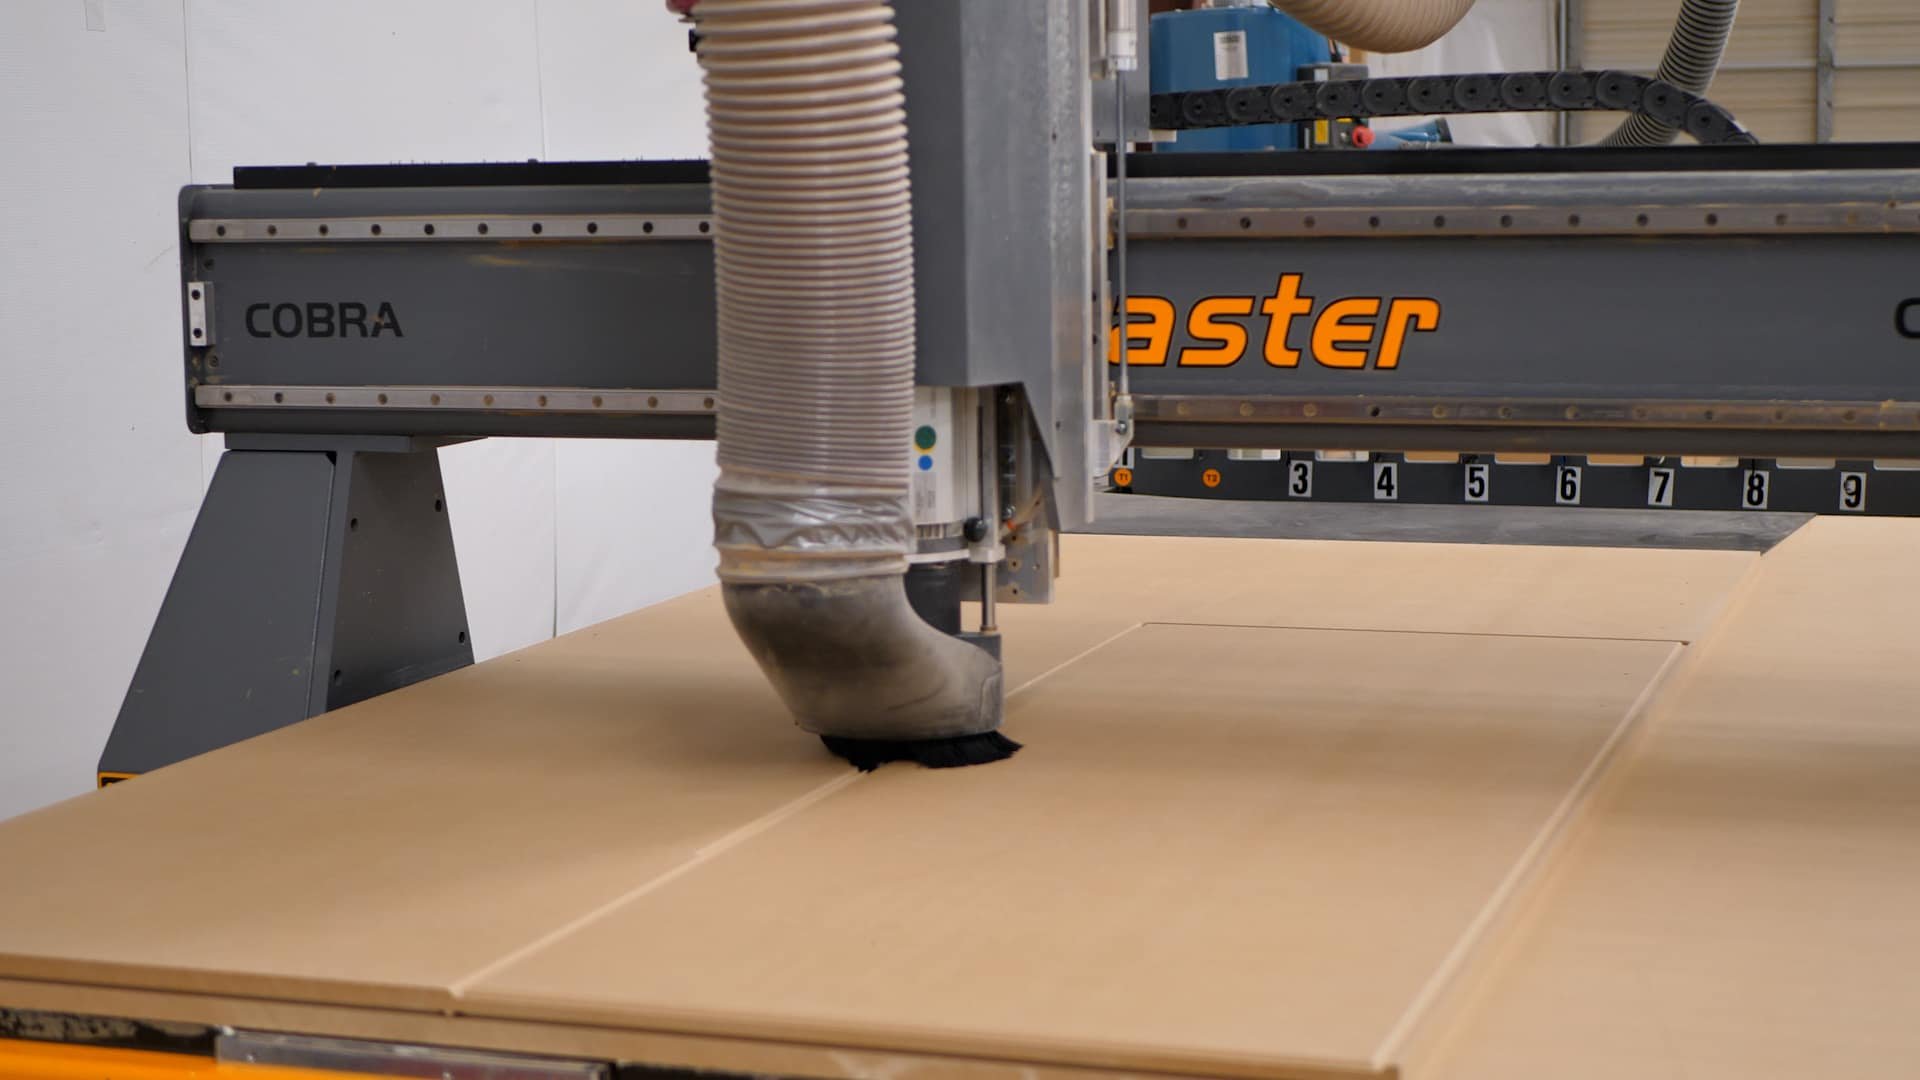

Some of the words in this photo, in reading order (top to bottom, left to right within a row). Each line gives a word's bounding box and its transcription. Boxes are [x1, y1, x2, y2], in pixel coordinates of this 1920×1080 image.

[246, 301, 404, 338] COBRA
[1292, 465, 1309, 497] 3
[1377, 467, 1395, 499] 4
[1468, 467, 1486, 500] 5
[1560, 469, 1578, 502] 6
[1654, 473, 1671, 505] 7
[1747, 474, 1766, 508] 8
[1843, 476, 1863, 510] 9
